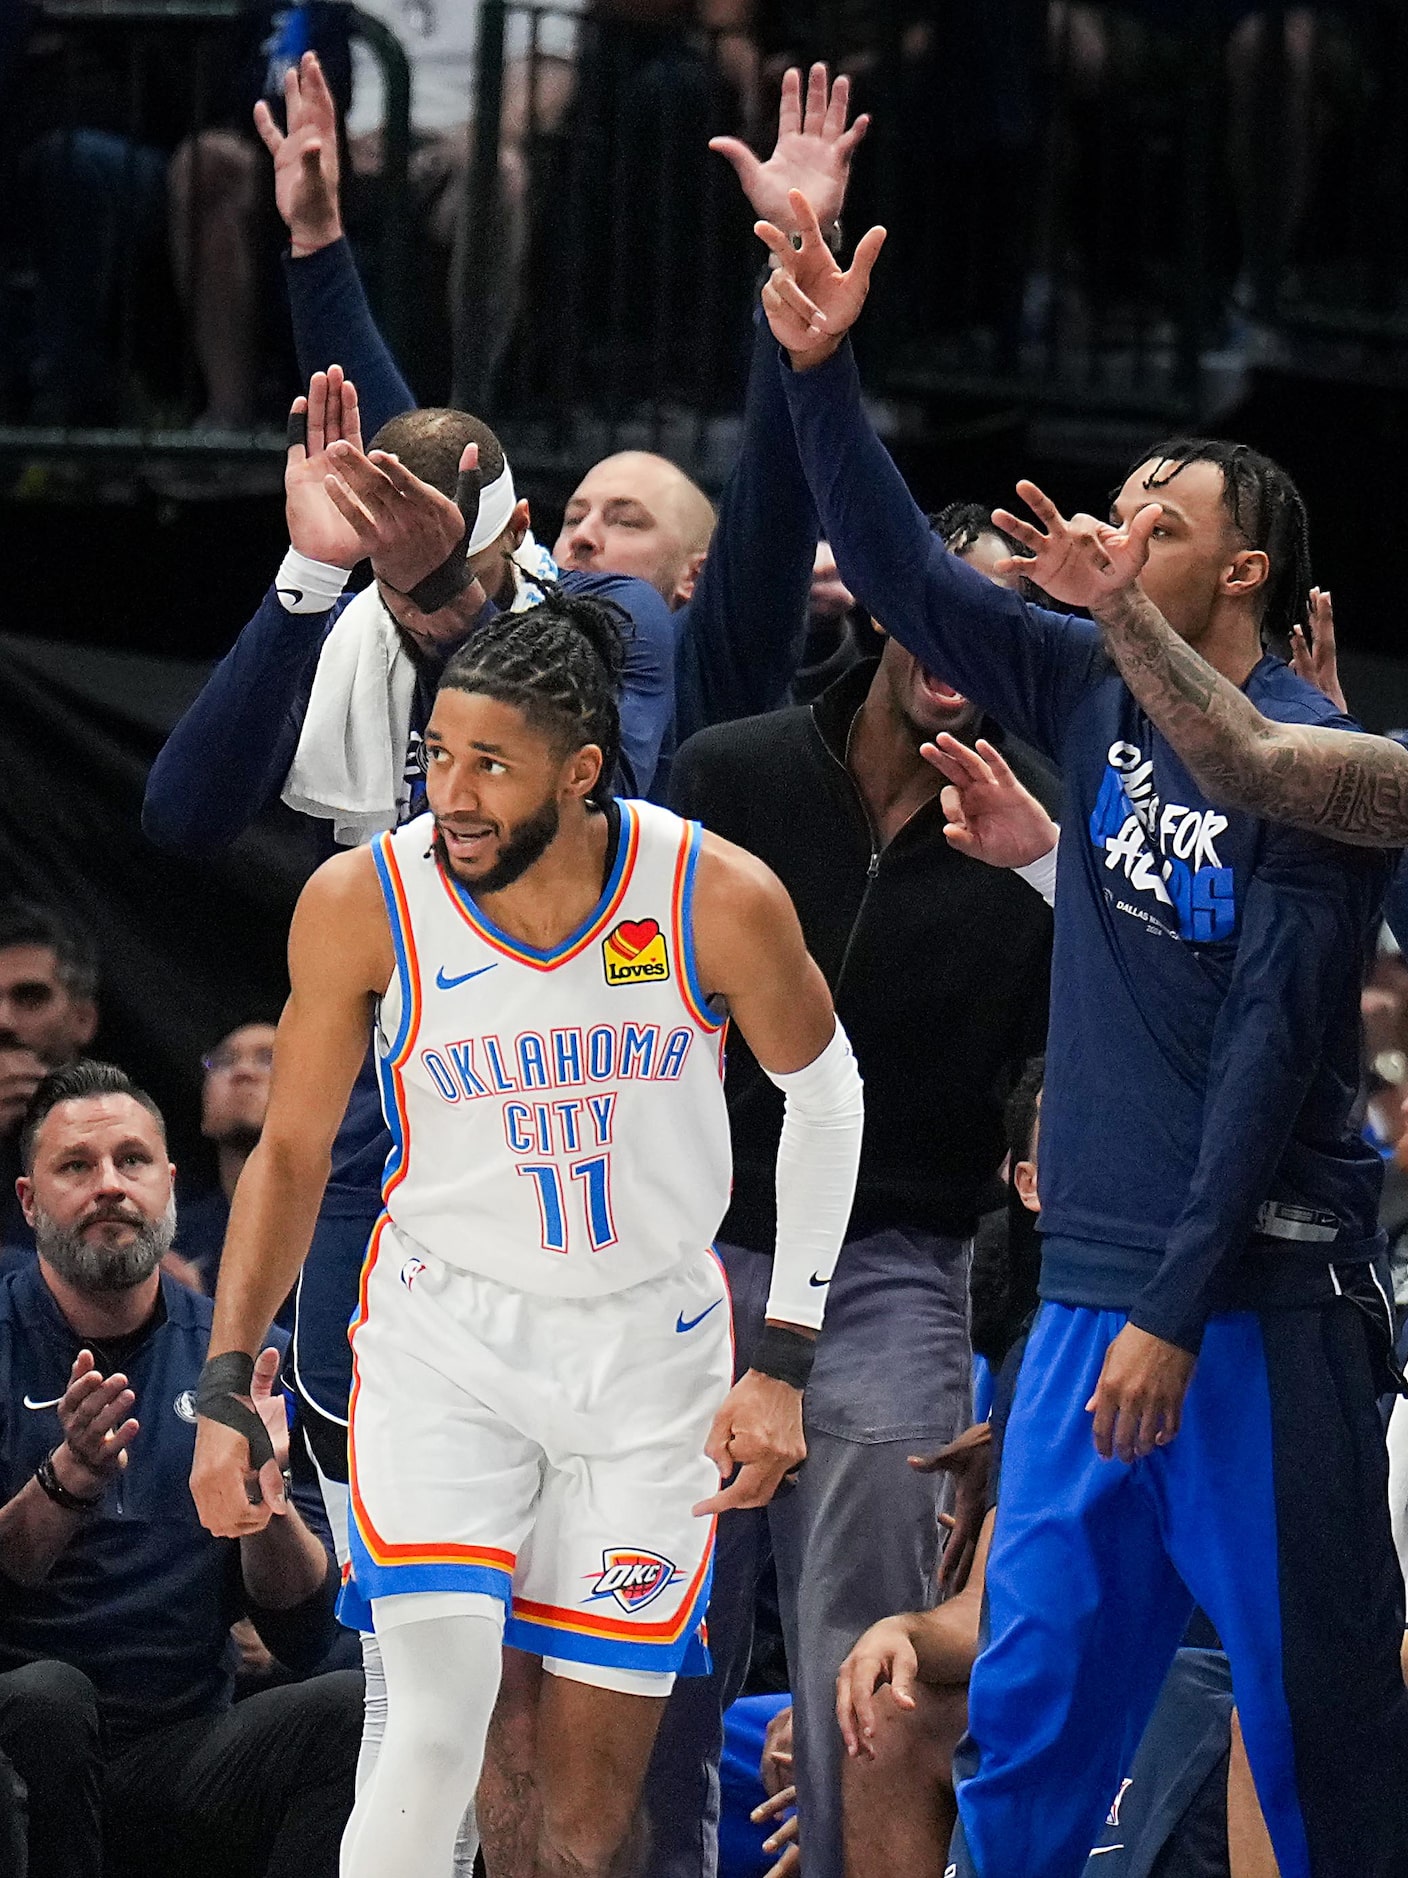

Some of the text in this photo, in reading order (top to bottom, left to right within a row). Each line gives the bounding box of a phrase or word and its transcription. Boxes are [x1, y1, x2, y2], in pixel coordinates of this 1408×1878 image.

[1160, 803, 1228, 874] FOR
[1116, 900, 1149, 921] DALLAS
[421, 1022, 694, 1103] OKLAHOMA
[503, 1092, 617, 1155] CITY
[516, 1153, 618, 1253] 11
[594, 1564, 661, 1593] OKC
